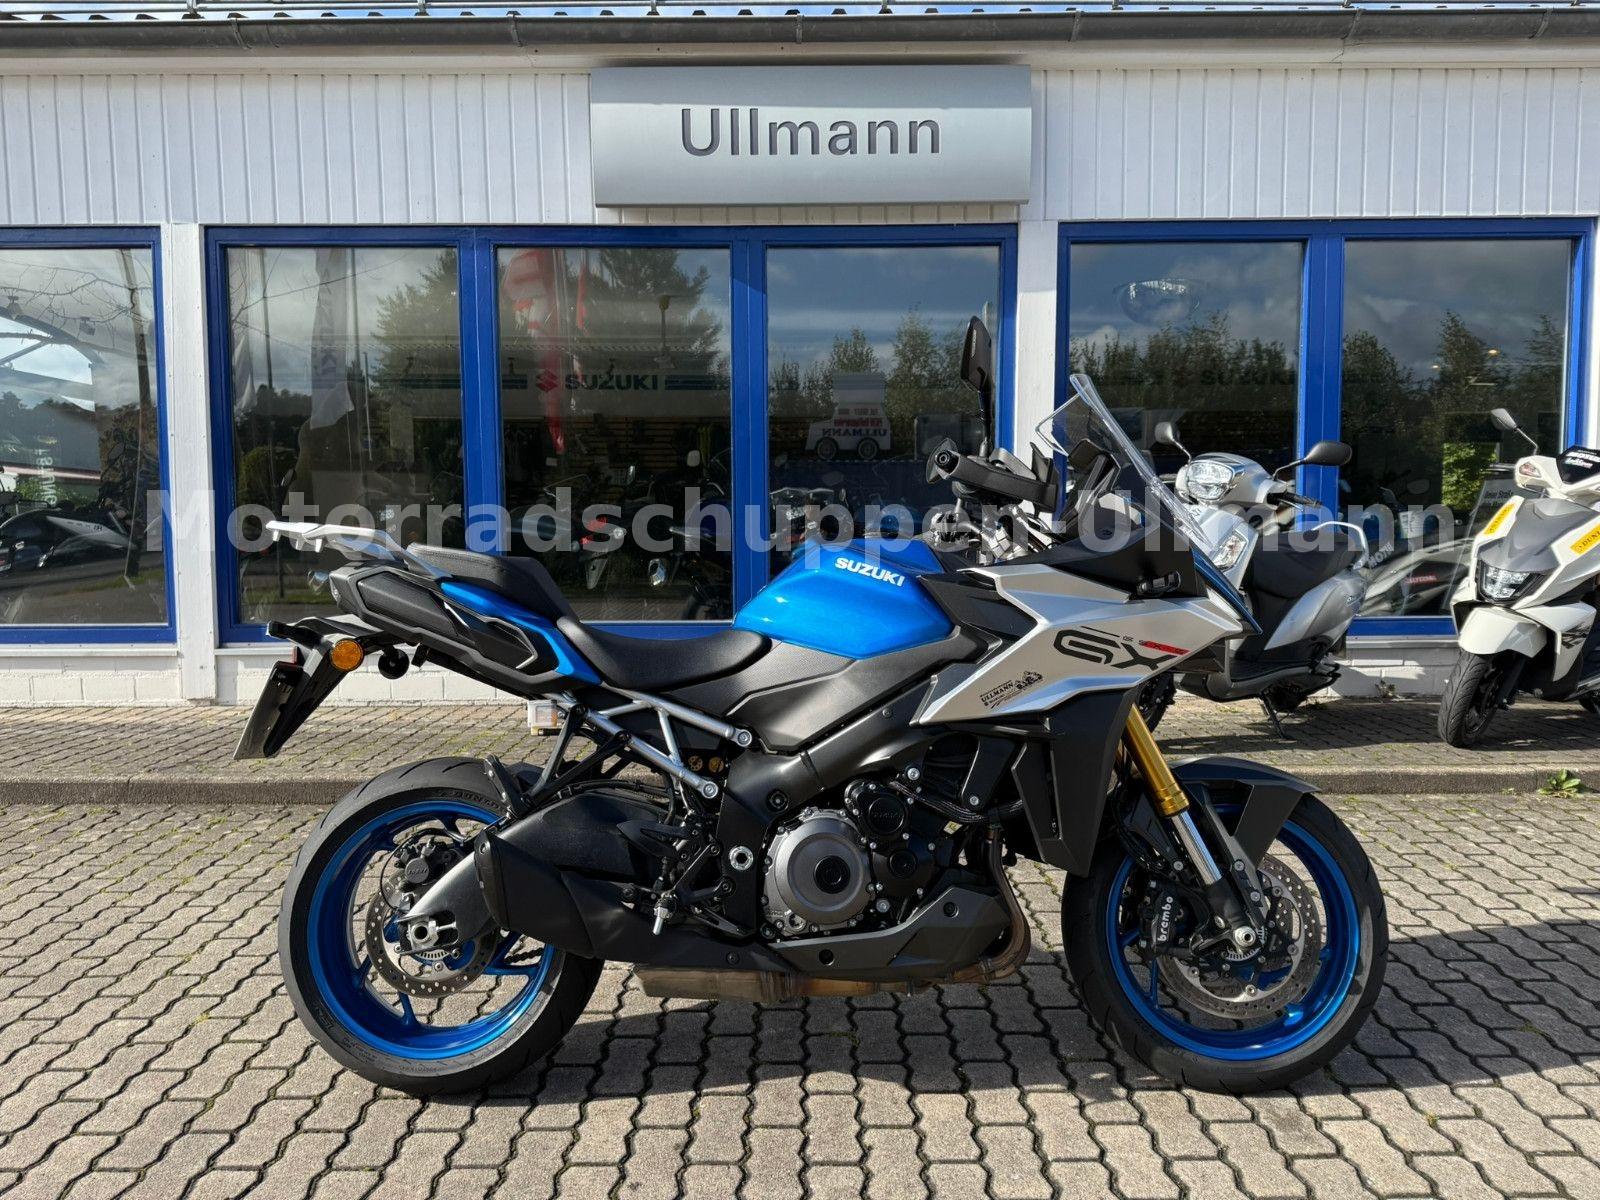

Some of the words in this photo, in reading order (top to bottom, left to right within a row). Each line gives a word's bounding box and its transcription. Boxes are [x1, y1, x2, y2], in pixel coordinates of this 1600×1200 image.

[681, 107, 941, 157] Ullmann
[564, 374, 659, 391] SUZUKI
[834, 556, 905, 588] SUZUKI
[1156, 896, 1174, 942] brembo
